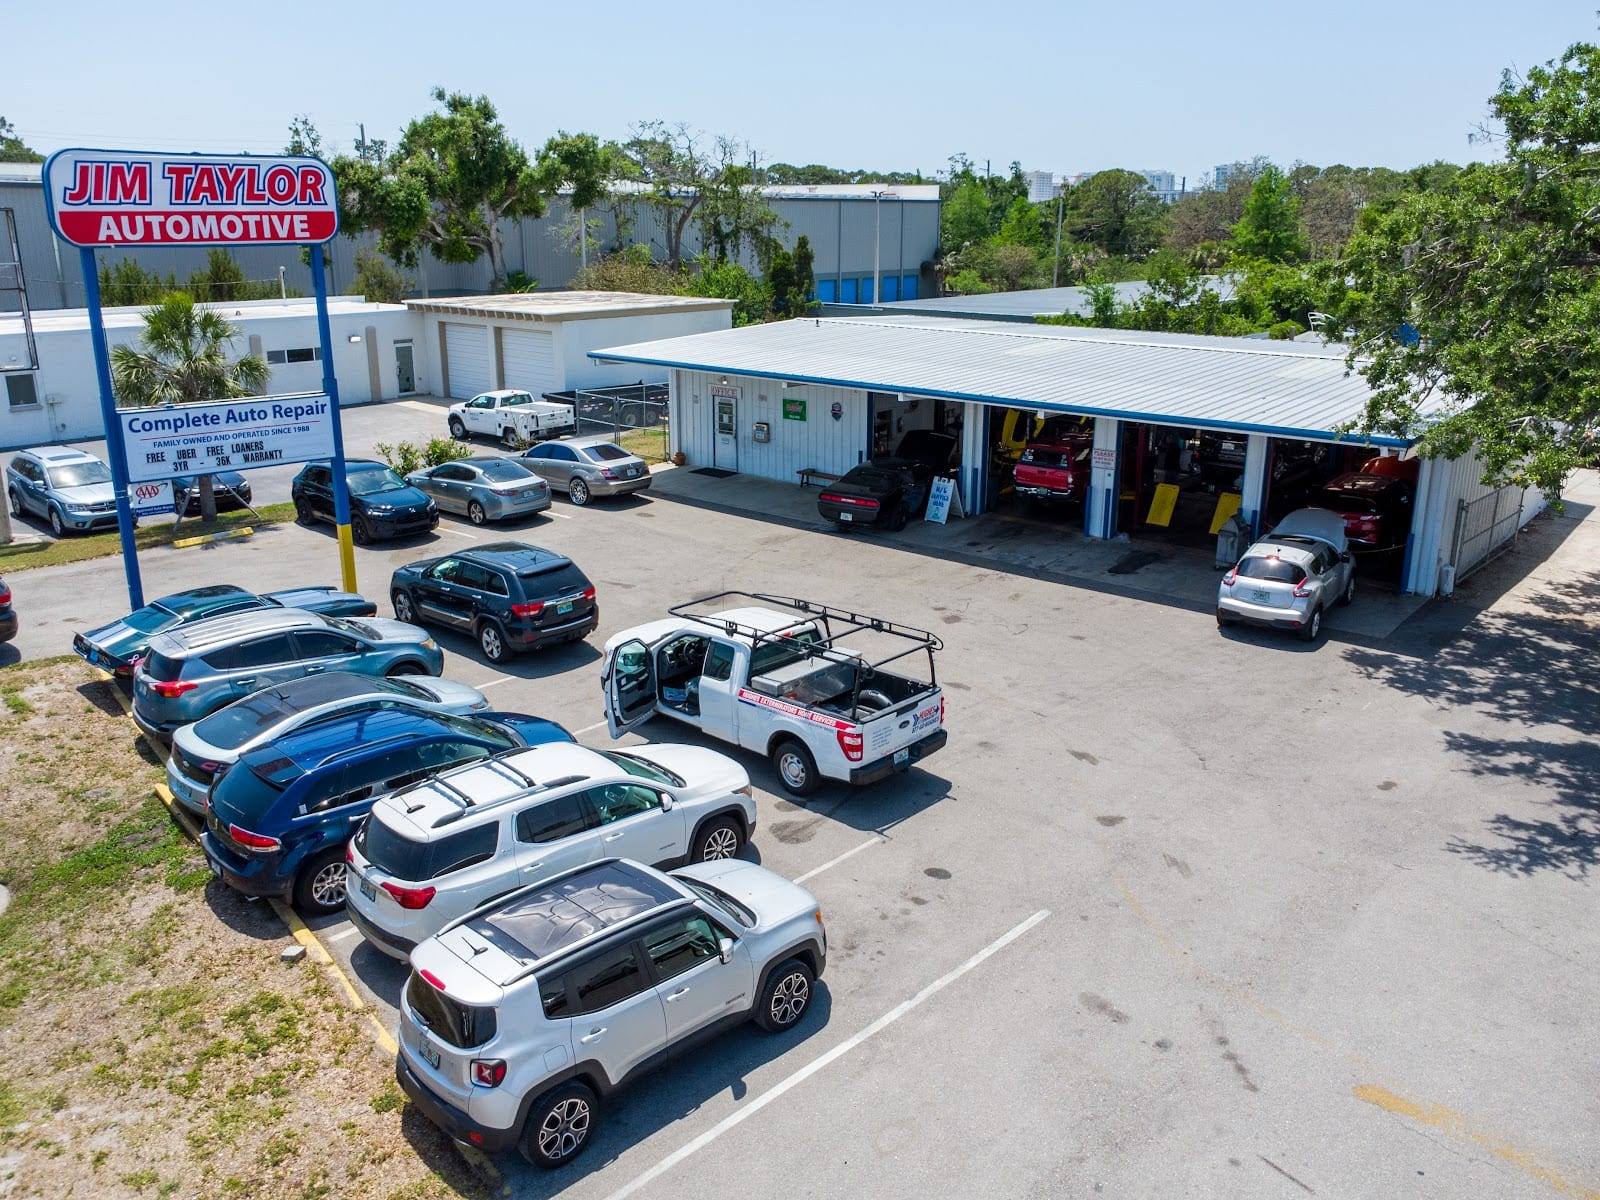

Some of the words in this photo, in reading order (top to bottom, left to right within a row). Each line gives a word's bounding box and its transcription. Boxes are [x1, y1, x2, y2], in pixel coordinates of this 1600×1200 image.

[64, 161, 152, 205] JIM
[163, 162, 327, 206] TAYLOR
[98, 214, 310, 241] AUTOMOTIVE
[128, 413, 220, 434] Complete
[225, 408, 268, 424] Auto
[272, 400, 327, 421] Repair
[153, 438, 181, 448] FAMILY
[183, 435, 212, 446] OWNED
[213, 433, 231, 442] AND
[232, 429, 270, 440] OPERATED
[271, 427, 292, 436] SINCE
[293, 425, 310, 433] 1988
[146, 451, 166, 464] FREE
[176, 449, 197, 460] UBER
[206, 444, 225, 457] FREE
[231, 441, 264, 454] LOANERS
[173, 461, 189, 472] 3YR
[216, 455, 231, 467] 36K
[243, 450, 283, 463] WARRANTY
[811, 713, 836, 727] SERVICES
